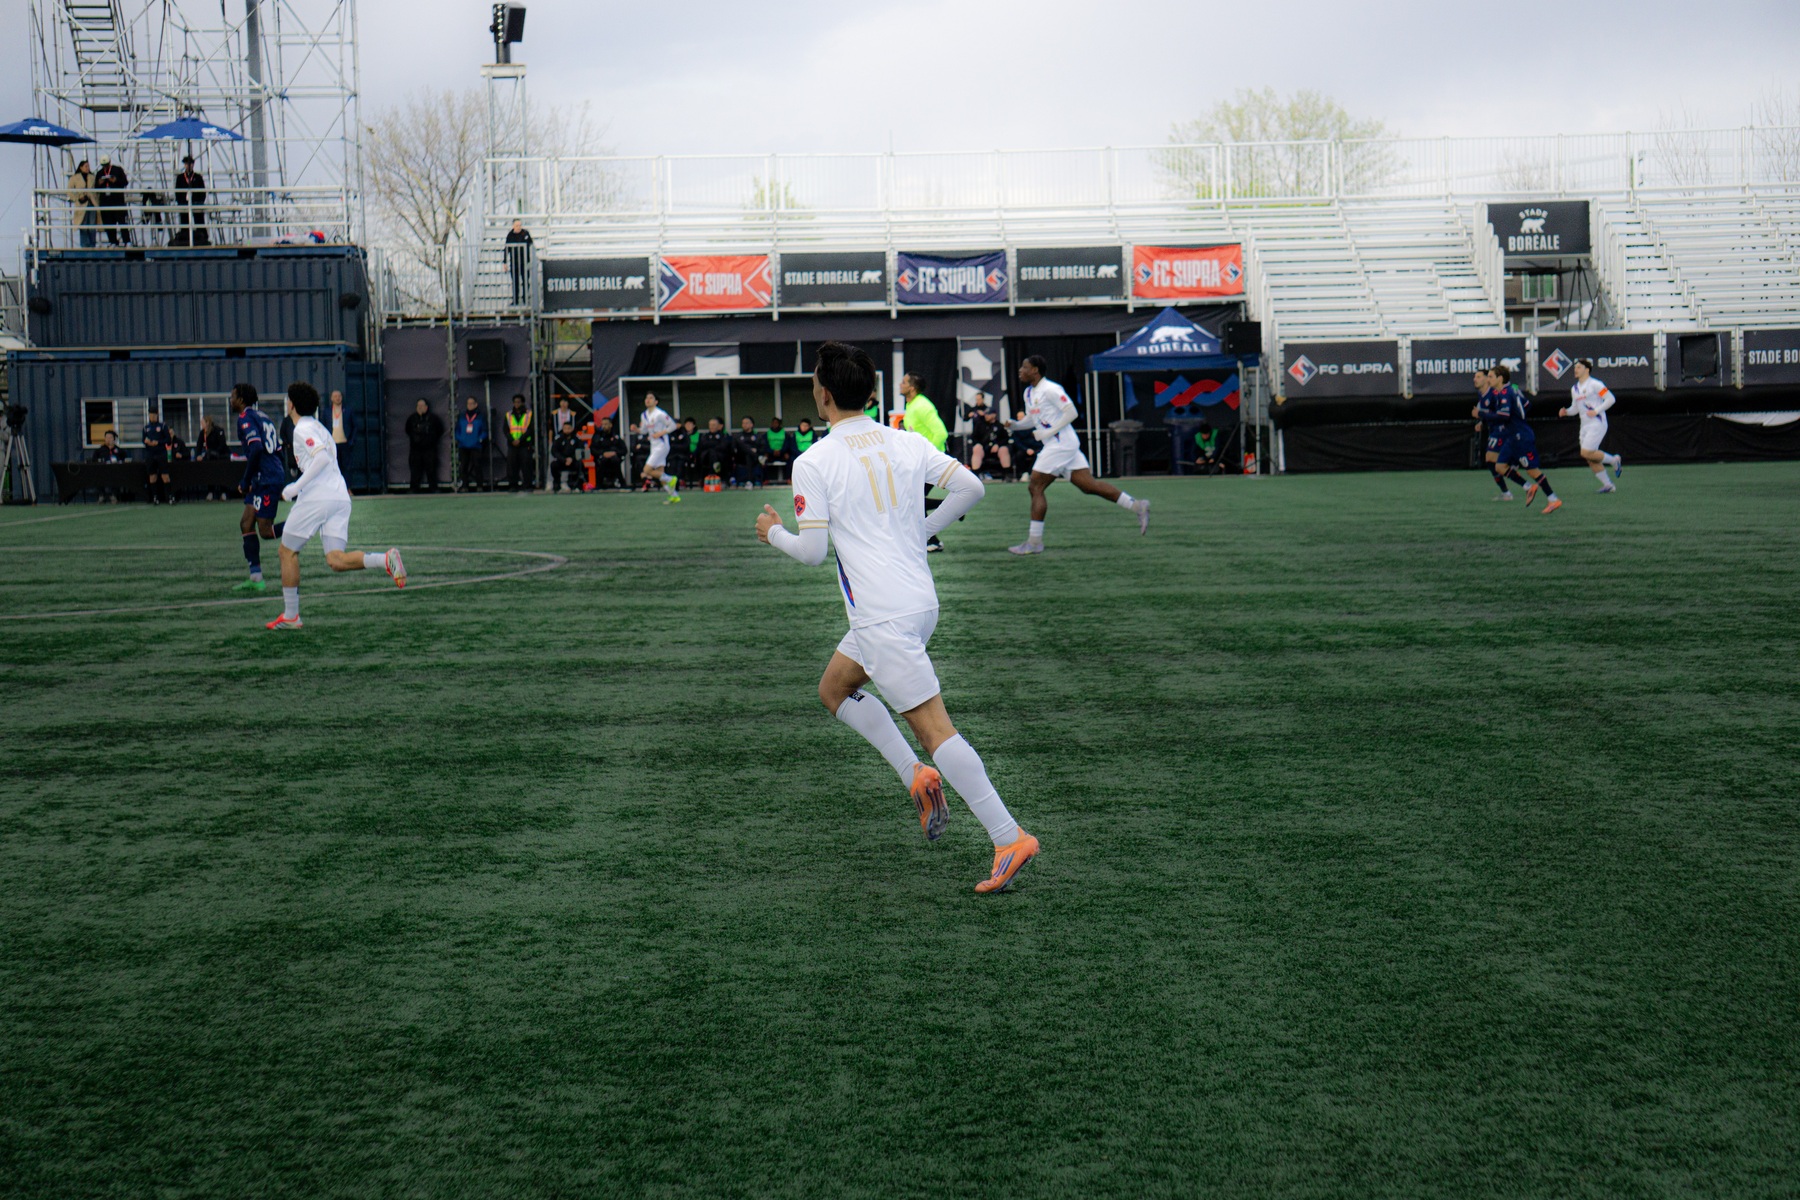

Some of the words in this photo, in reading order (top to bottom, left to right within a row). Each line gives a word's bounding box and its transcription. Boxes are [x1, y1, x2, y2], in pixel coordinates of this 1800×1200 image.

[1519, 208, 1548, 219] STADE
[1508, 234, 1560, 252] BORÉALE
[785, 271, 815, 285] STADE
[816, 269, 860, 284] BORÉALE
[918, 267, 935, 294] FC
[938, 265, 987, 294] SUPRA
[1020, 266, 1051, 281] STADE
[1052, 264, 1096, 279] BORÉALE
[1153, 260, 1170, 288] FC
[1172, 259, 1222, 288] SUPRA
[547, 278, 577, 292] STADE
[579, 276, 623, 292] BORÉALE
[689, 273, 703, 295] FC
[705, 272, 742, 295] SUPRA
[1597, 356, 1649, 369] SUPRA
[1748, 350, 1782, 365] STADE
[1783, 349, 1800, 363] BO
[1319, 364, 1339, 375] FC
[1342, 362, 1394, 375] SUPRA
[1415, 359, 1448, 375] STADE
[843, 430, 885, 450] PINTO
[859, 451, 899, 515] 11
